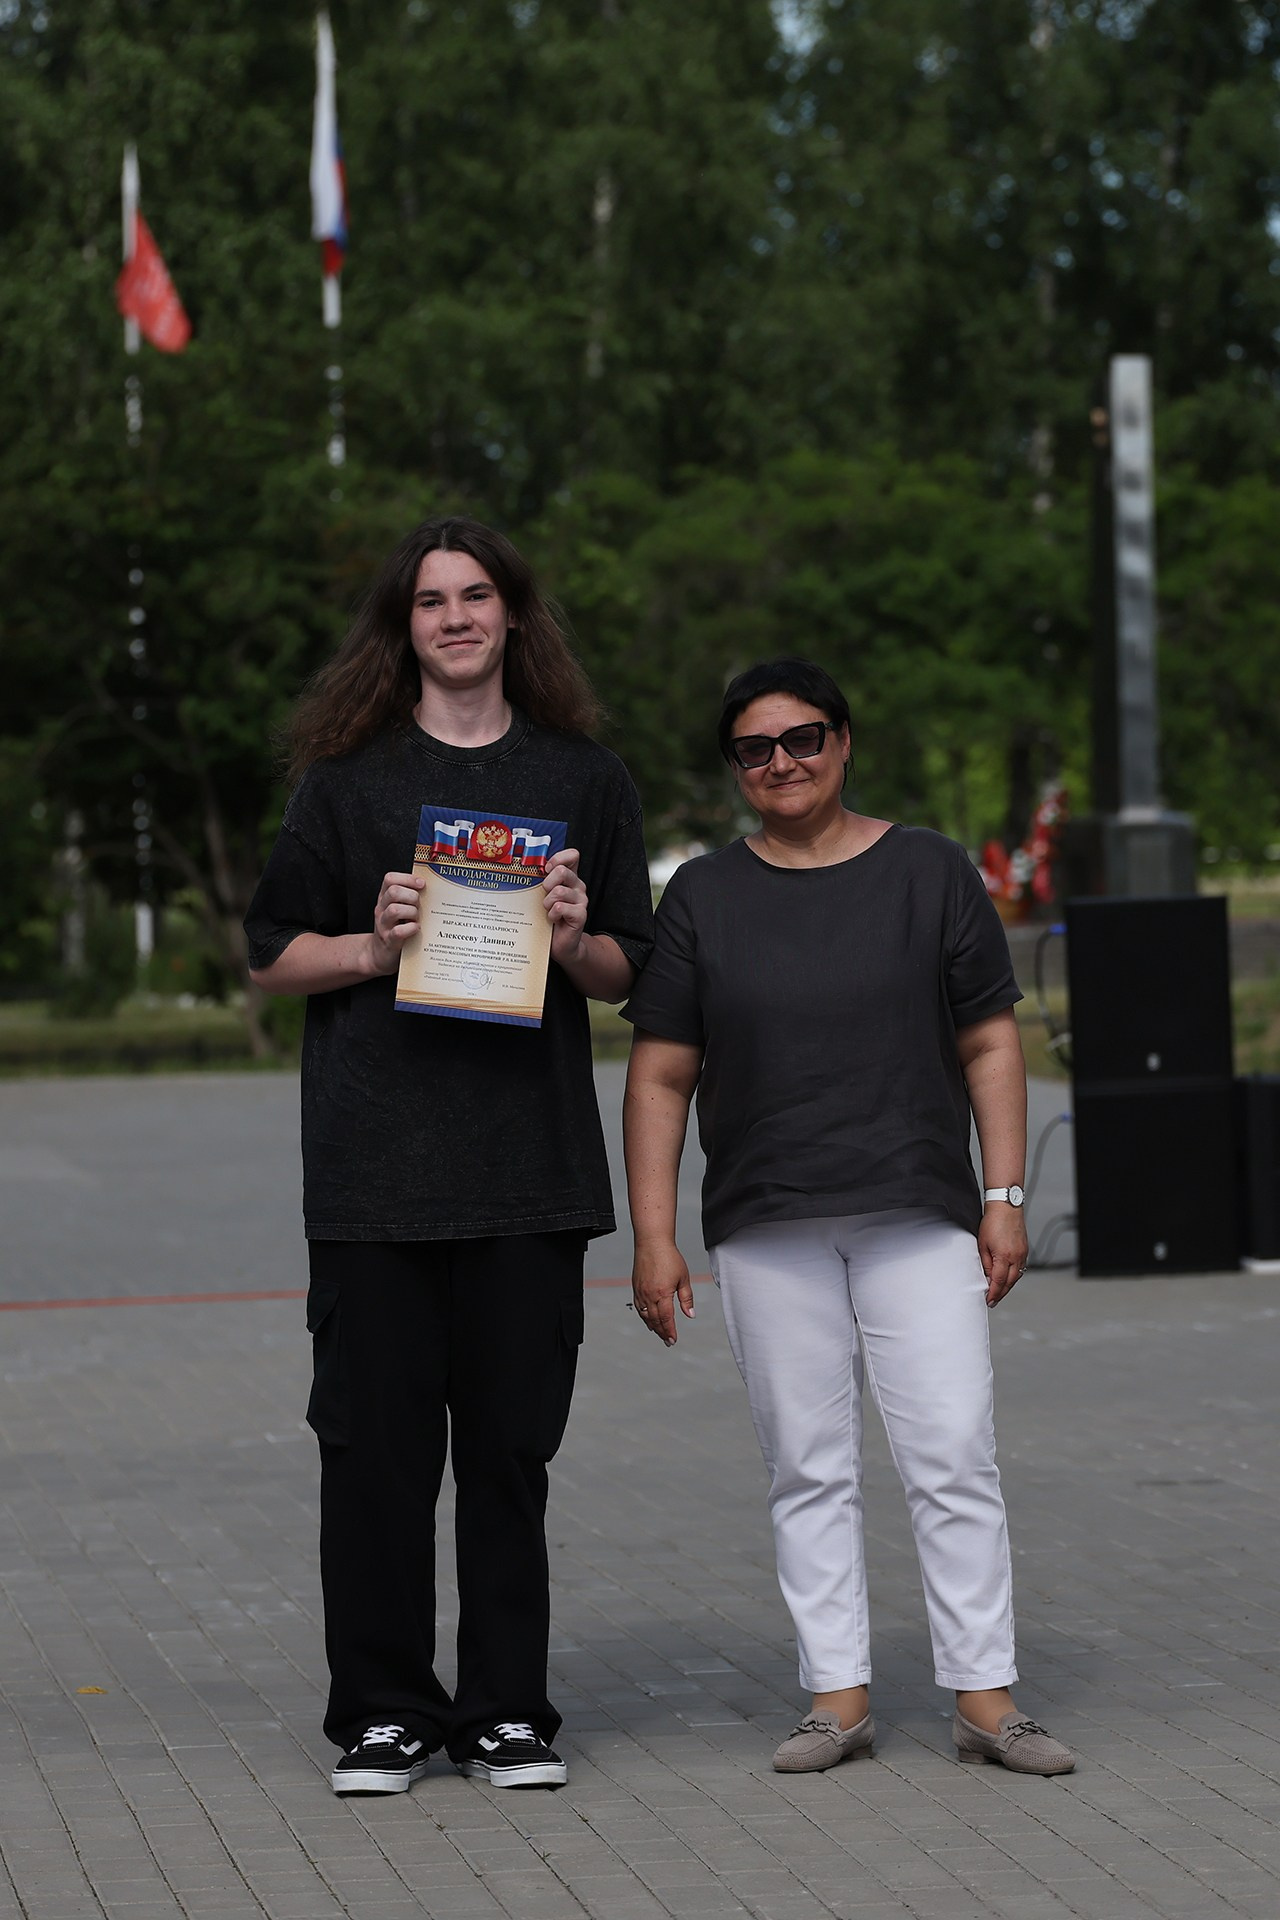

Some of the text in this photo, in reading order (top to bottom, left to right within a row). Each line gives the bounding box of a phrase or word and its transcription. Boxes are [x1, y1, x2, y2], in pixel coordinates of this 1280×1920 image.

[440, 866, 532, 886] БЛАГОДАРСТВЕННОЕ
[467, 879, 499, 889] ПИСЬМО
[443, 920, 519, 933] ВЫРАЖАЕТ БЛАГОДАРНОСТЬ
[437, 931, 516, 948] Алексееву Даниилу
